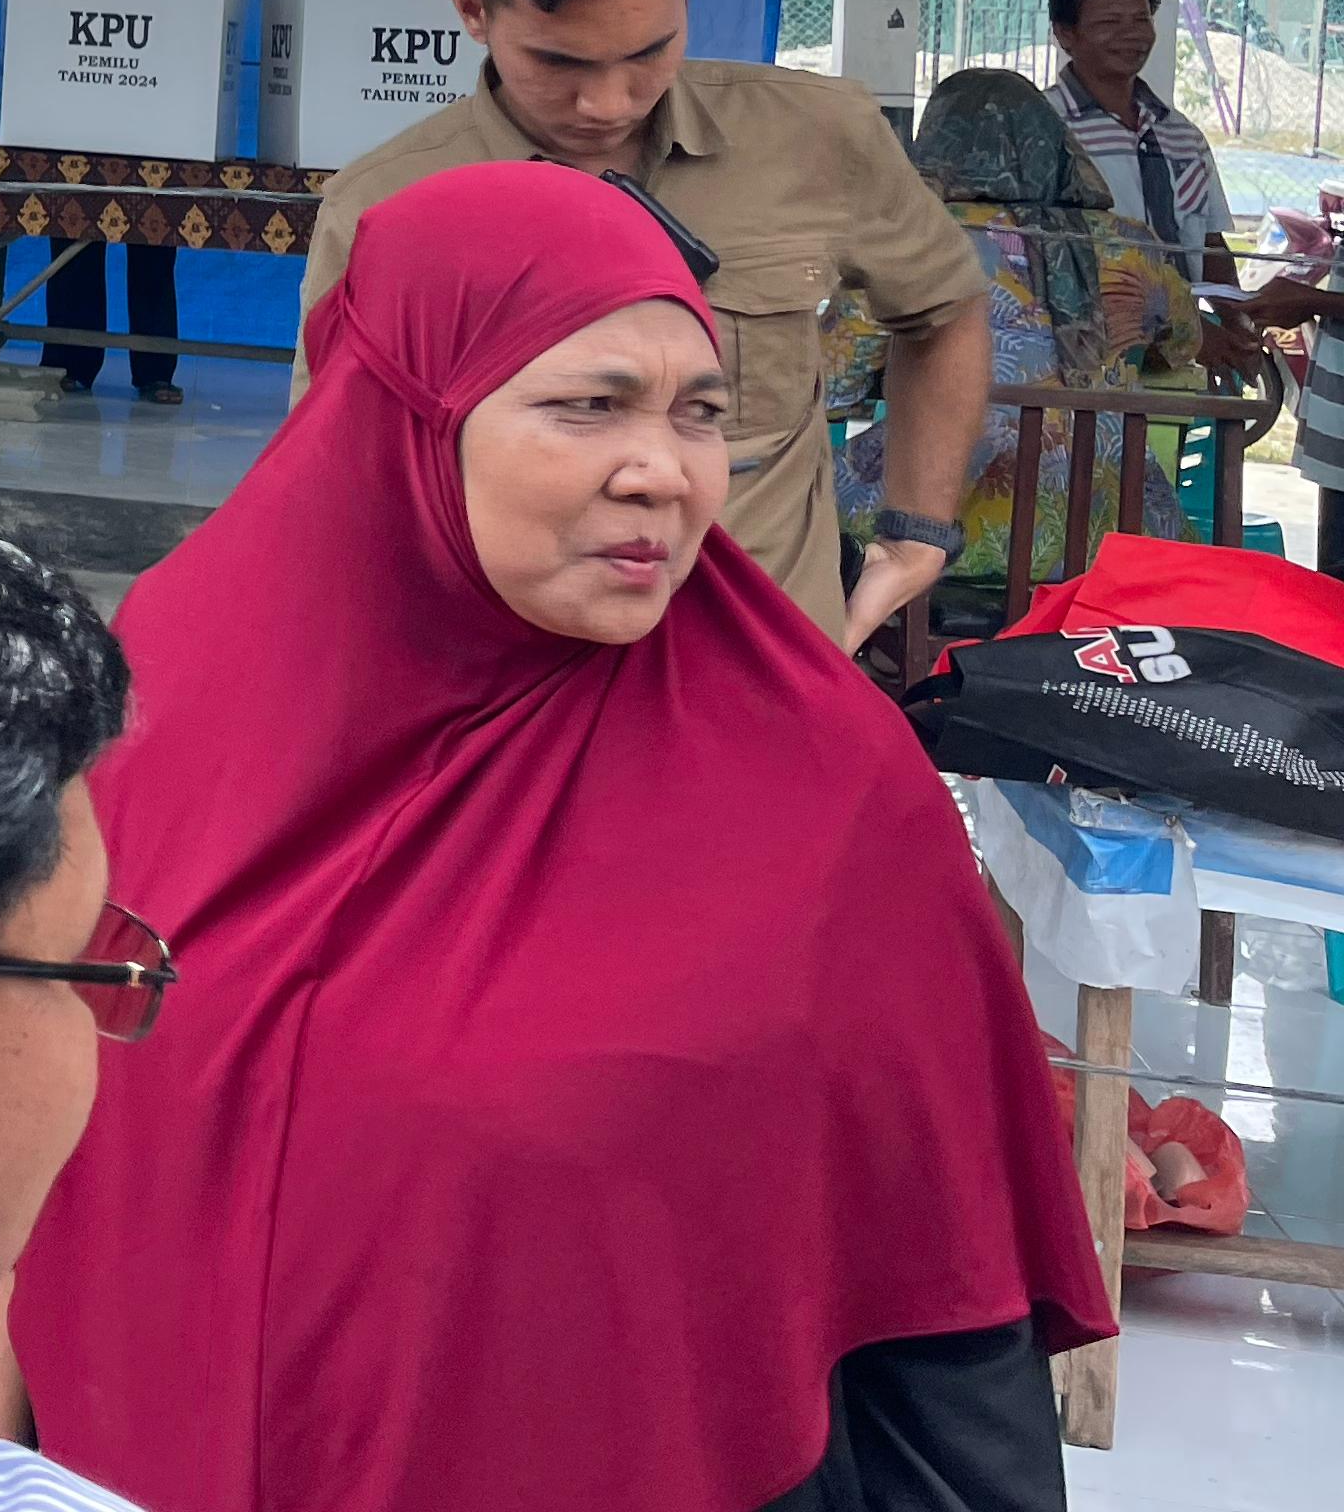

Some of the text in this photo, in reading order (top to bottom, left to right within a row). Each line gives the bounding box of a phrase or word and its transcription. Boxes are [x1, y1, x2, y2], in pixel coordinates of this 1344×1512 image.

[69, 11, 153, 49] KPU
[270, 24, 293, 59] KPU
[371, 28, 461, 65] KPU
[78, 55, 140, 69] PEMILU
[58, 70, 158, 88] TAHUN 2024
[382, 72, 448, 87] PEMILU
[361, 88, 420, 102] TAHUN
